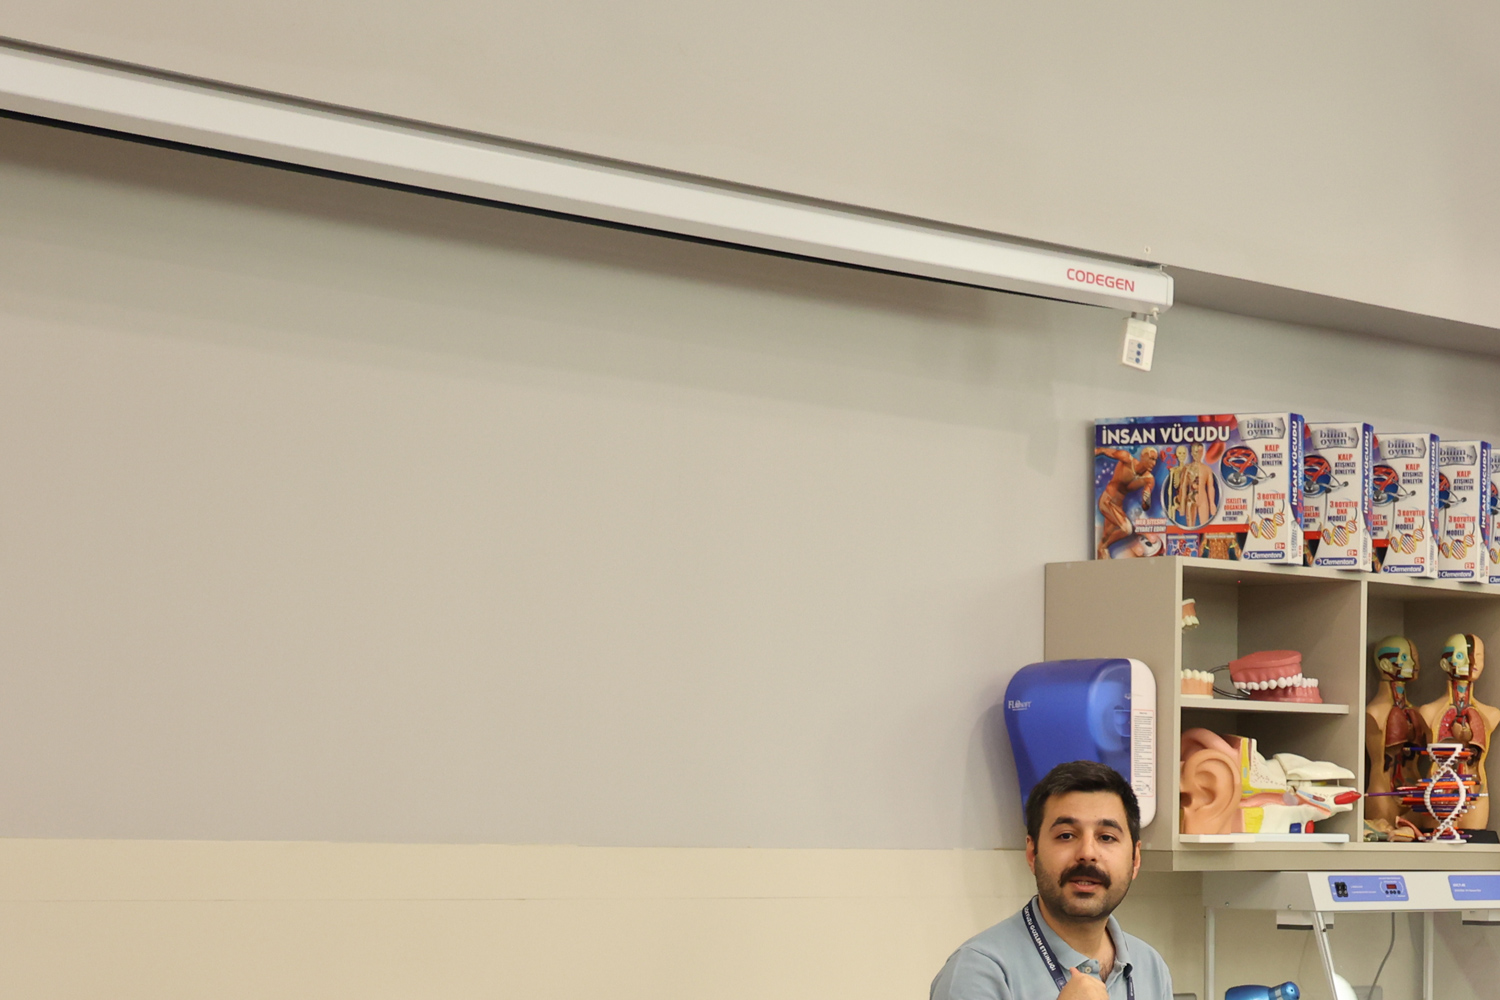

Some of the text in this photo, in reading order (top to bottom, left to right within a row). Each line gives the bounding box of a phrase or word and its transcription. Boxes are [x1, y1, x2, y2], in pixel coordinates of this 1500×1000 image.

[1066, 268, 1135, 292] CODEGEN
[1102, 423, 1230, 444] İNSAN VÜCUDU
[1265, 444, 1280, 452] KALP
[1338, 453, 1353, 461] KALP
[1405, 463, 1420, 471] KALP
